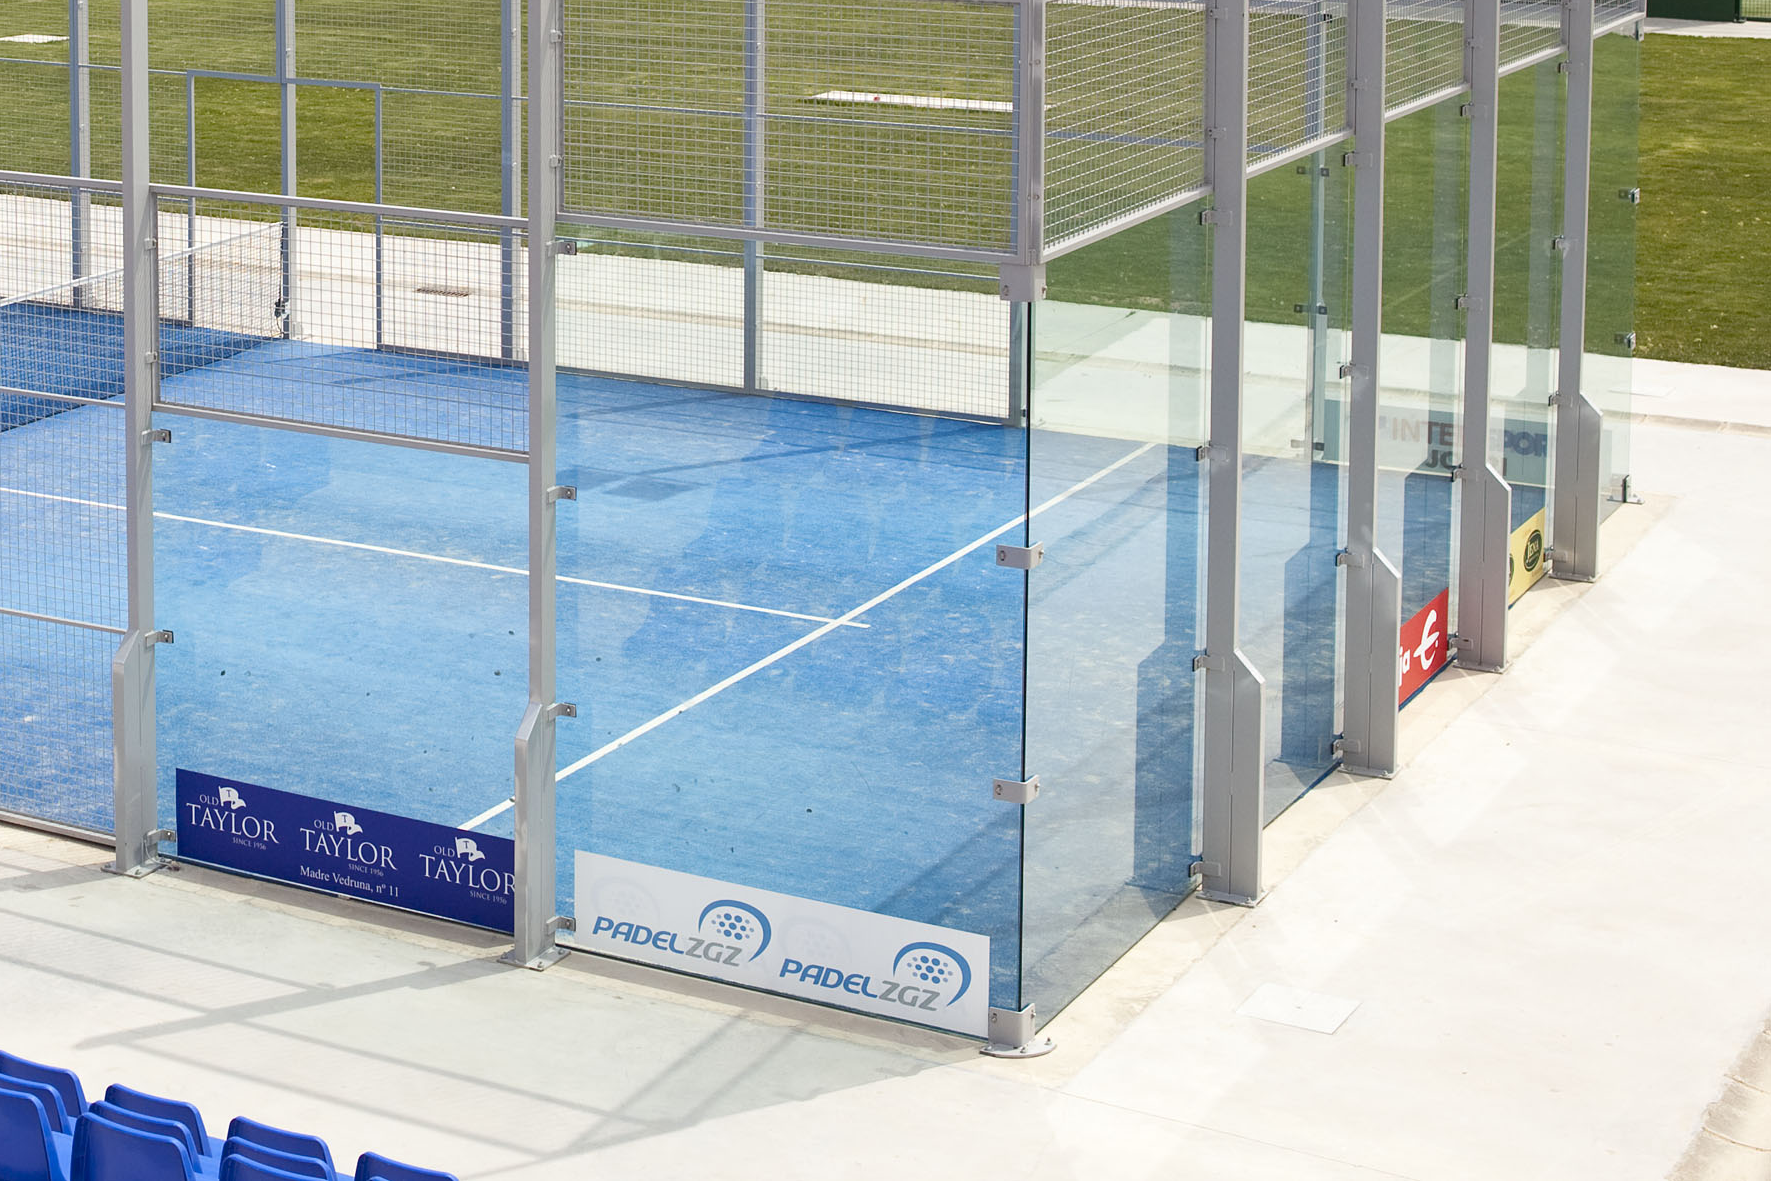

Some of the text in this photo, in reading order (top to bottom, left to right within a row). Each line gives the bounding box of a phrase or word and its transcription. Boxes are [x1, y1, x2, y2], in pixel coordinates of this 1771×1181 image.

[200, 794, 219, 806] OLD
[186, 803, 280, 844] TAYLOR
[313, 819, 334, 832] OLD
[300, 827, 397, 871] TAYLOR
[433, 845, 455, 858] OLD
[348, 863, 368, 874] SINCE
[419, 853, 515, 896] TAYLOR
[300, 865, 330, 882] Madre
[332, 871, 374, 894] Vedruna,
[388, 885, 399, 898] 11
[470, 890, 491, 901] SINCE
[592, 915, 941, 1012] PADELZGZ PADELZGZ
